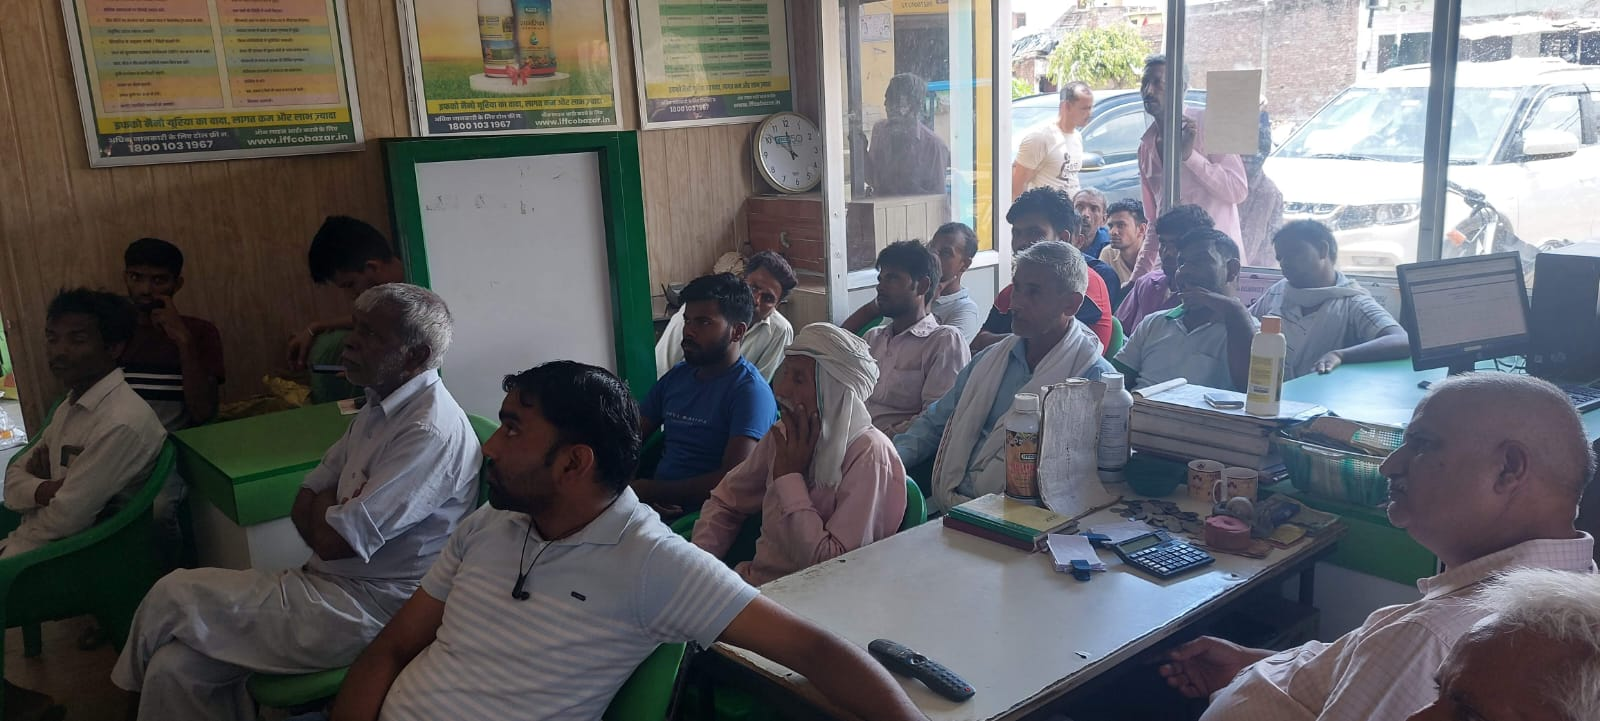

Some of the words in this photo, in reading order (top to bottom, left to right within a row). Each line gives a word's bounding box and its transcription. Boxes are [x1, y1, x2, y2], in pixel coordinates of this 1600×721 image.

[168, 116, 194, 129] यूरिया
[196, 117, 208, 126] का
[231, 115, 256, 124] लागत
[257, 114, 274, 122] कम
[277, 112, 292, 121] और
[294, 112, 313, 122] लाभ
[449, 122, 472, 130] 1800
[474, 121, 489, 129] 103
[490, 120, 511, 128] 1967
[535, 116, 610, 126] www.iffcobazar.in
[782, 119, 789, 128] 12
[247, 133, 348, 146] www.iffcobazar.in
[129, 143, 160, 153] 1800
[162, 142, 184, 151] 103
[186, 140, 214, 149] 1967
[763, 151, 769, 159] 9
[795, 178, 800, 186] 6
